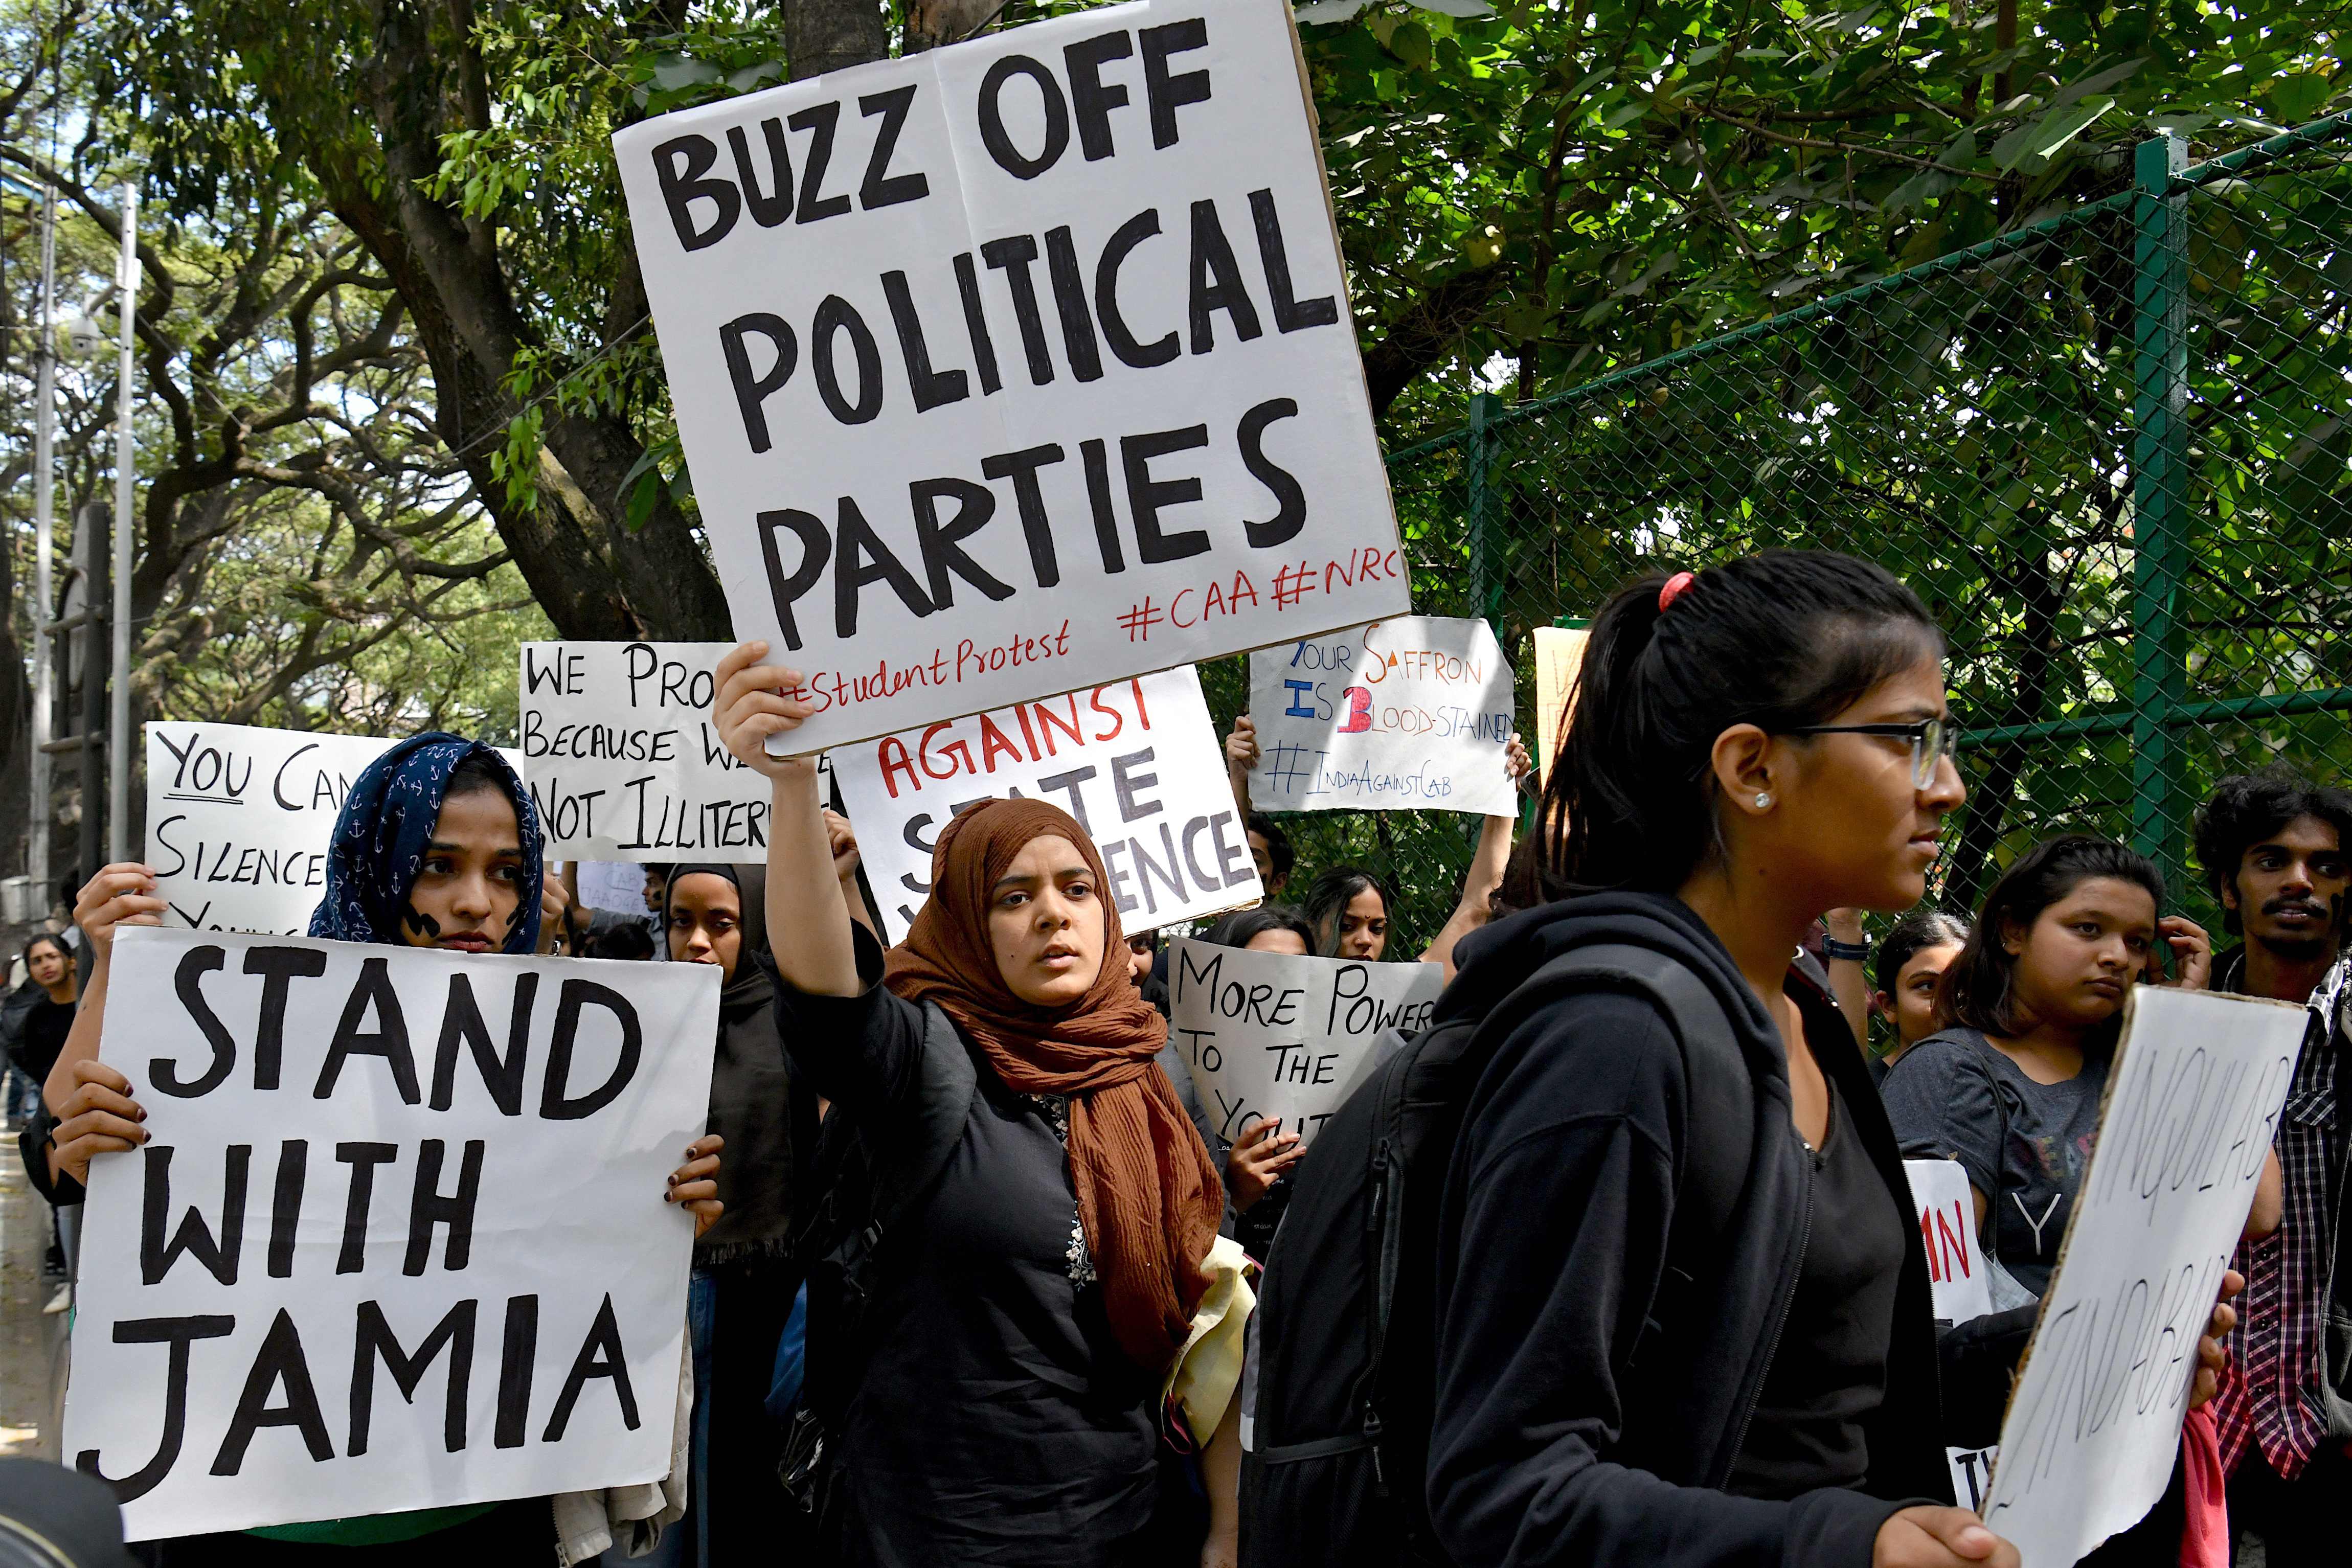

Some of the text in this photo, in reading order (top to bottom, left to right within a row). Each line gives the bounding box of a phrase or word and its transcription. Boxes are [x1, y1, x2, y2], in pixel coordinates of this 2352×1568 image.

[652, 17, 1211, 252] BUZZ OFF
[719, 188, 1338, 453] POLITICAL
[757, 398, 1306, 651] PARTIES
[1116, 570, 1259, 642] #CAA
[1271, 548, 1396, 611] #NRC
[527, 643, 714, 709] WE PRO
[1291, 624, 1481, 685] YOUR SAFFRON
[525, 711, 750, 770] BECAUSE W
[1284, 679, 1333, 721] IS
[155, 731, 251, 797] YOU
[155, 815, 325, 887] SILENCE
[531, 775, 771, 849] NOT ILLITER
[901, 746, 1163, 894] STE
[1178, 947, 1435, 1036] MORE POWER
[149, 946, 642, 1121] STAND
[1178, 1028, 1339, 1084] TO THE
[1214, 1089, 1335, 1155] YOUT
[141, 1139, 485, 1285] WITH
[76, 1292, 641, 1505] JAMIA
